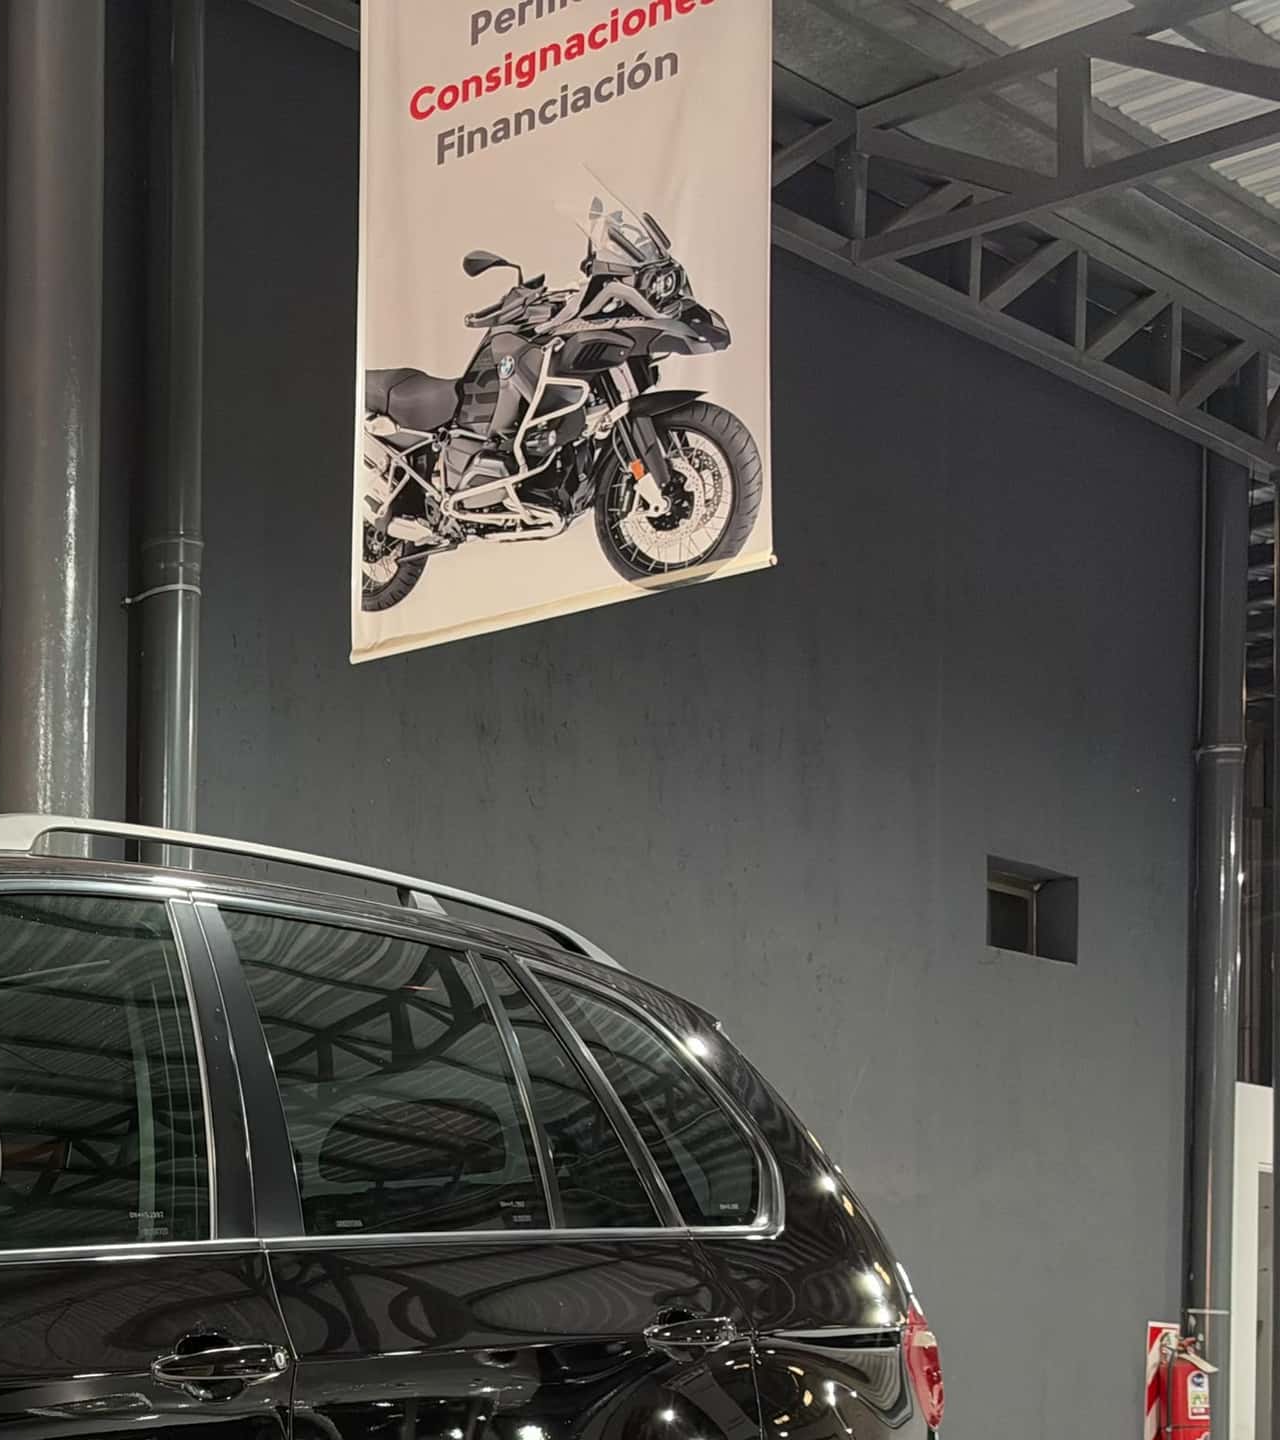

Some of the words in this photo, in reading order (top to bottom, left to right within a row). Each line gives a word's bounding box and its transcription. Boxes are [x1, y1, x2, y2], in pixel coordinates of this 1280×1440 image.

[409, 0, 718, 120] Consignacione
[470, 0, 582, 46] Perm
[436, 50, 679, 165] Financiación
